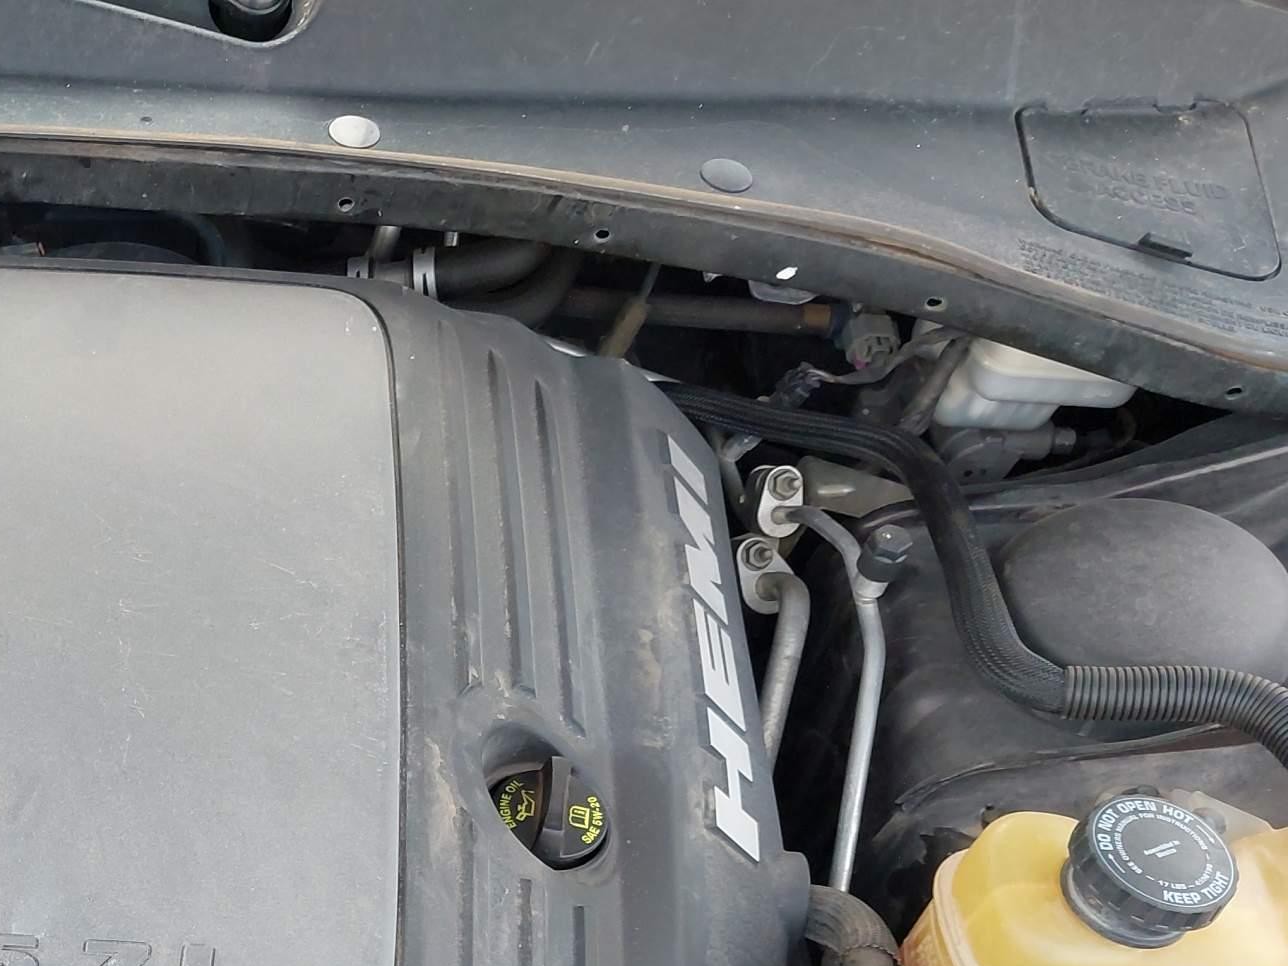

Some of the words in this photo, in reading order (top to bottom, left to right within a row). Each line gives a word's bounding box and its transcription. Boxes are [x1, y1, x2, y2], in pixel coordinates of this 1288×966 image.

[1096, 183, 1198, 215] ACCESS
[1153, 175, 1232, 200] FLUID
[667, 433, 760, 863] HEMI
[505, 779, 524, 793] OIL
[499, 791, 517, 829] ENGINE
[587, 796, 603, 826] 5W-20
[1118, 800, 1157, 814] OPEN
[1162, 804, 1194, 824] HOT
[1098, 809, 1119, 832] NOT
[581, 825, 600, 844] SAE
[1097, 833, 1113, 851] DO
[1163, 890, 1201, 904] KEEP
[1201, 872, 1230, 900] TIGHT
